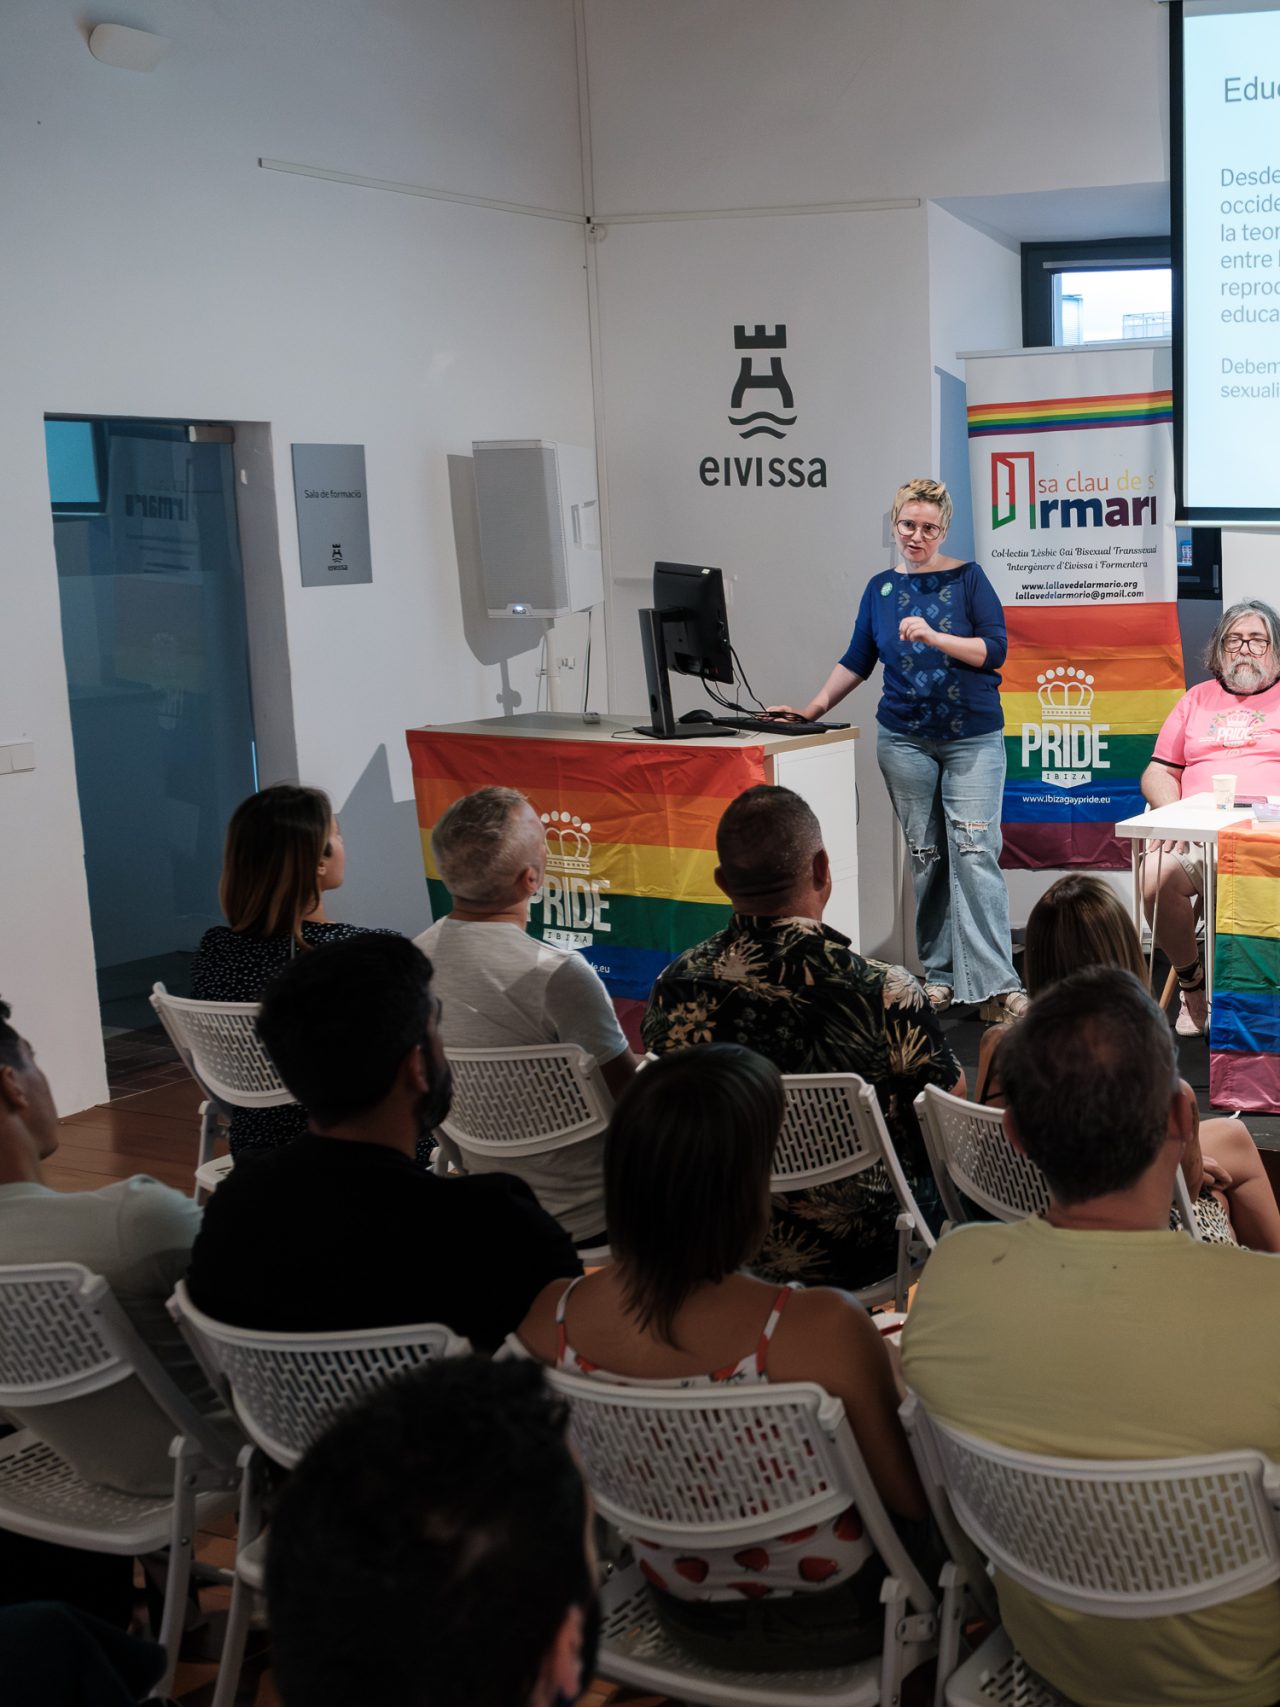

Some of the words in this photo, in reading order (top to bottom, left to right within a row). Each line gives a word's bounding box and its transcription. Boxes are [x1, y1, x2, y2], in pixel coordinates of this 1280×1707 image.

[1221, 223, 1236, 242] la
[1220, 251, 1273, 269] entre
[699, 456, 828, 488] eivissa
[1038, 479, 1058, 494] sa
[1066, 470, 1109, 493] clau
[1117, 468, 1141, 491] de
[1075, 546, 1111, 556] Bisexual
[1099, 560, 1148, 569] Formentera
[1021, 722, 1111, 769] PRIDE
[1022, 795, 1111, 806] www.ibizagaypride.eu
[547, 931, 587, 943] IBIZA
